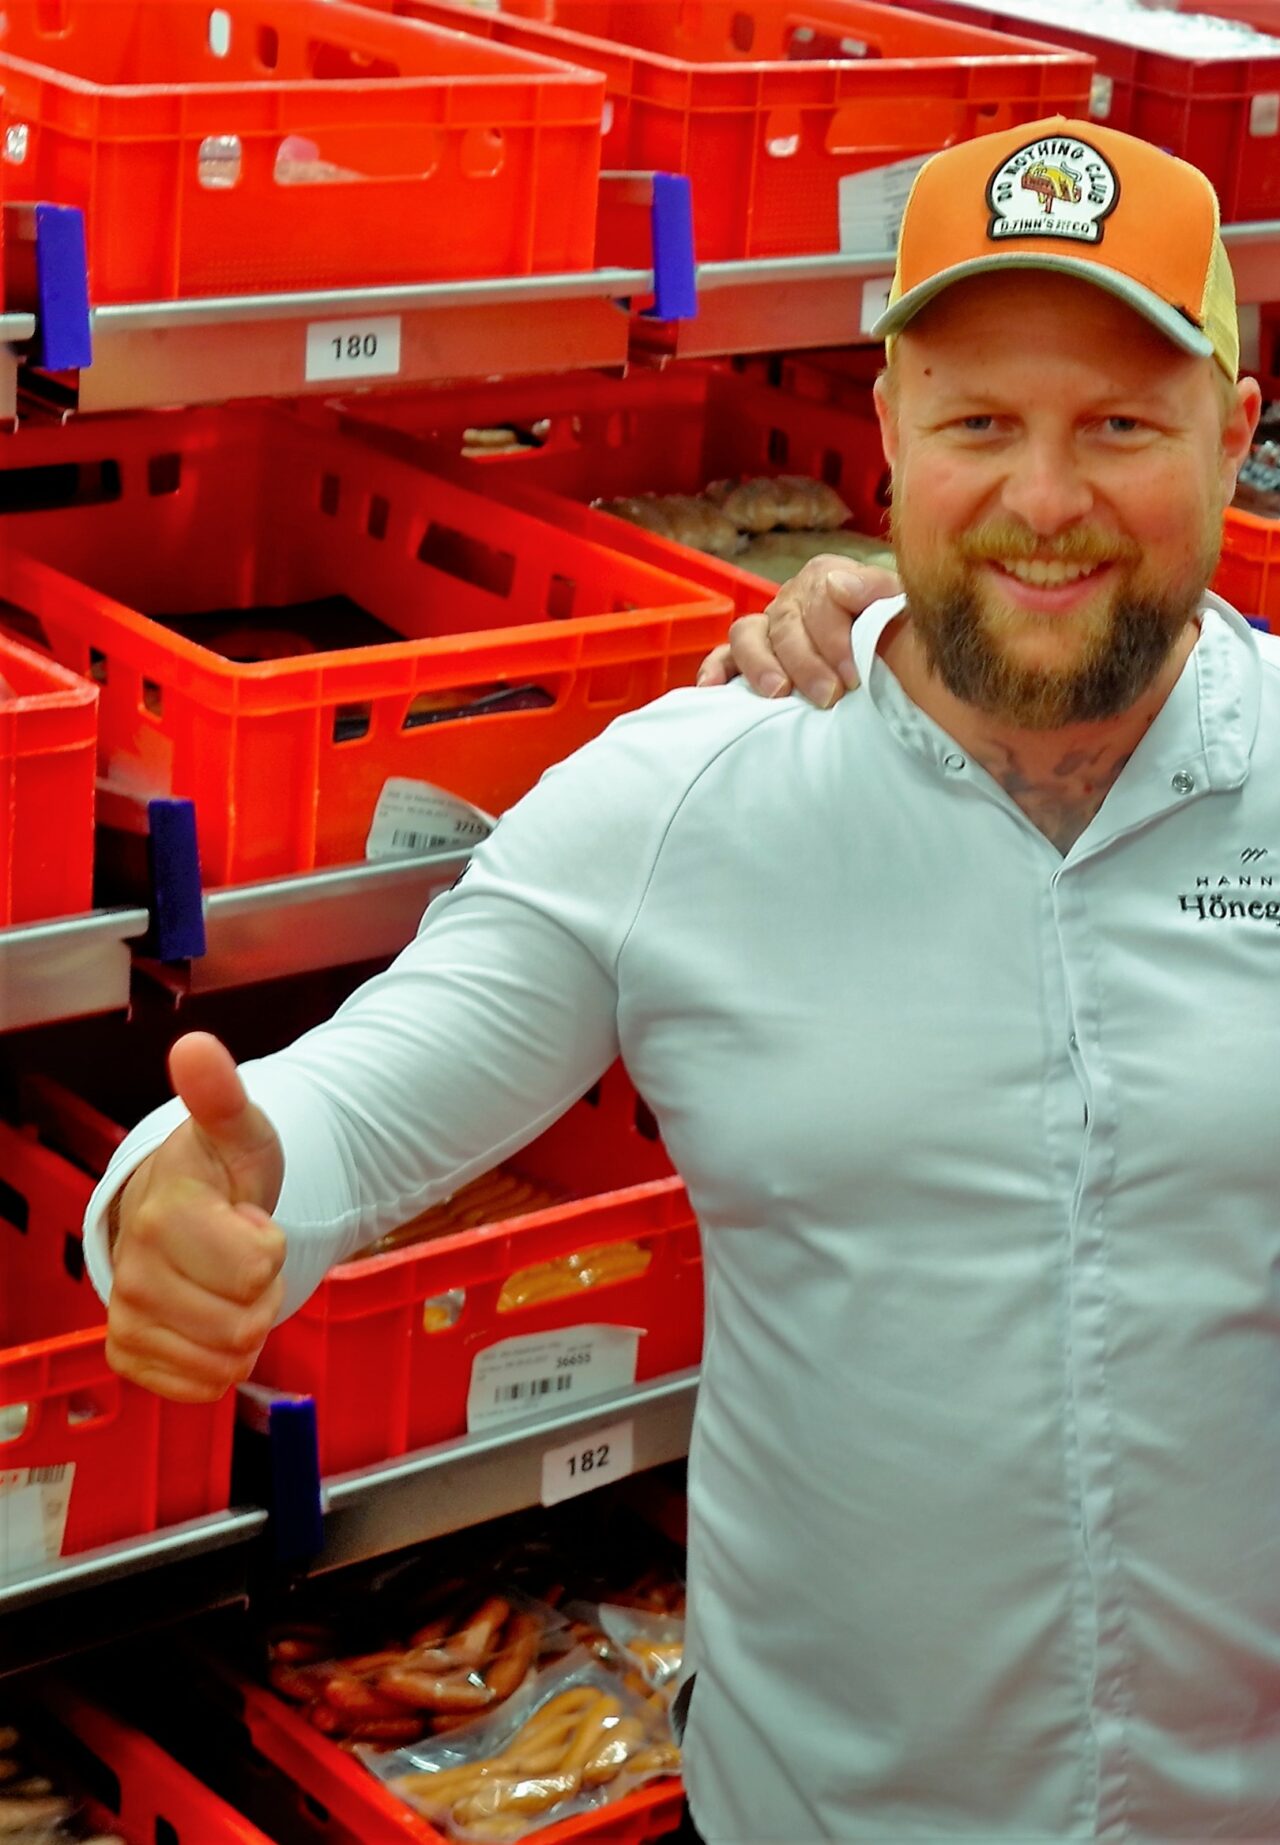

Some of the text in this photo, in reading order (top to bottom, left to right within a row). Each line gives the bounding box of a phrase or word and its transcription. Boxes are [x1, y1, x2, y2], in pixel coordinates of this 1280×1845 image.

[996, 140, 1107, 205] DO NOTHING CLUB
[331, 332, 377, 360] 180
[566, 1444, 611, 1478] 182
